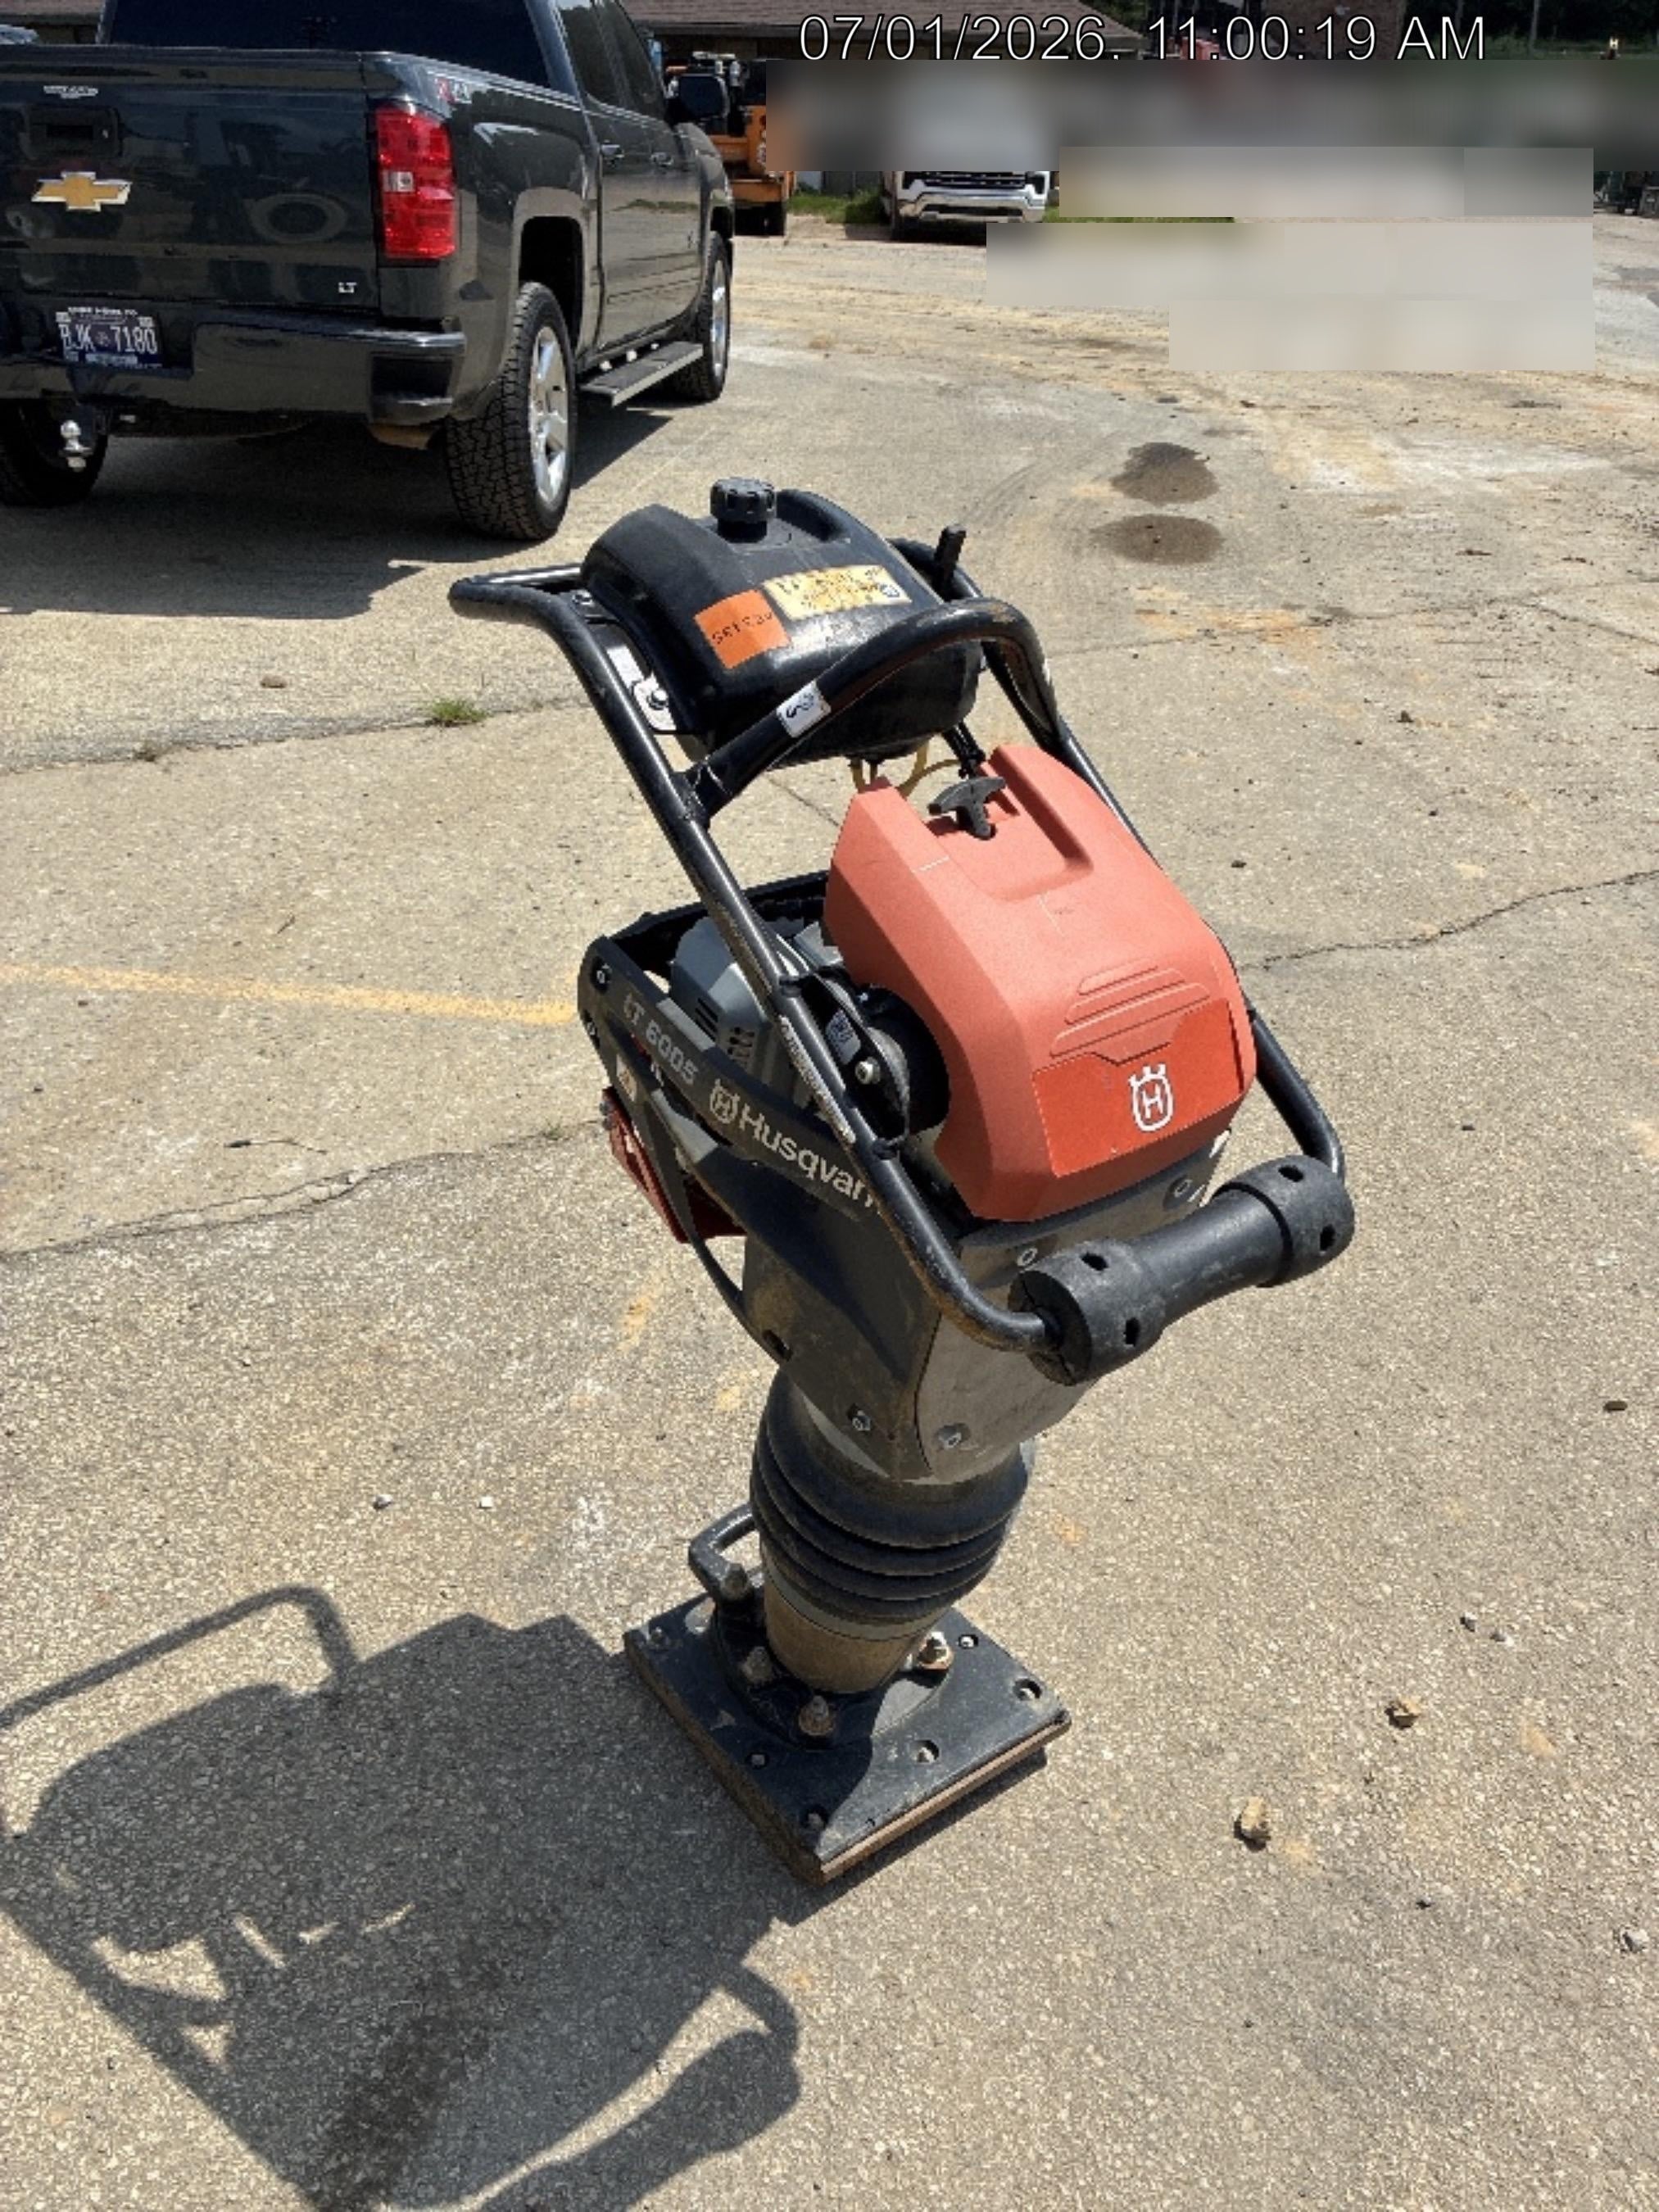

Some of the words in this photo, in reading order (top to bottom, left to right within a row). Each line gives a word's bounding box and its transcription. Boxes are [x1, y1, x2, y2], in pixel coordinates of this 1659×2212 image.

[109, 326, 158, 355] 7180
[646, 1019, 698, 1085] 6005
[739, 1103, 873, 1208] Husqvar
